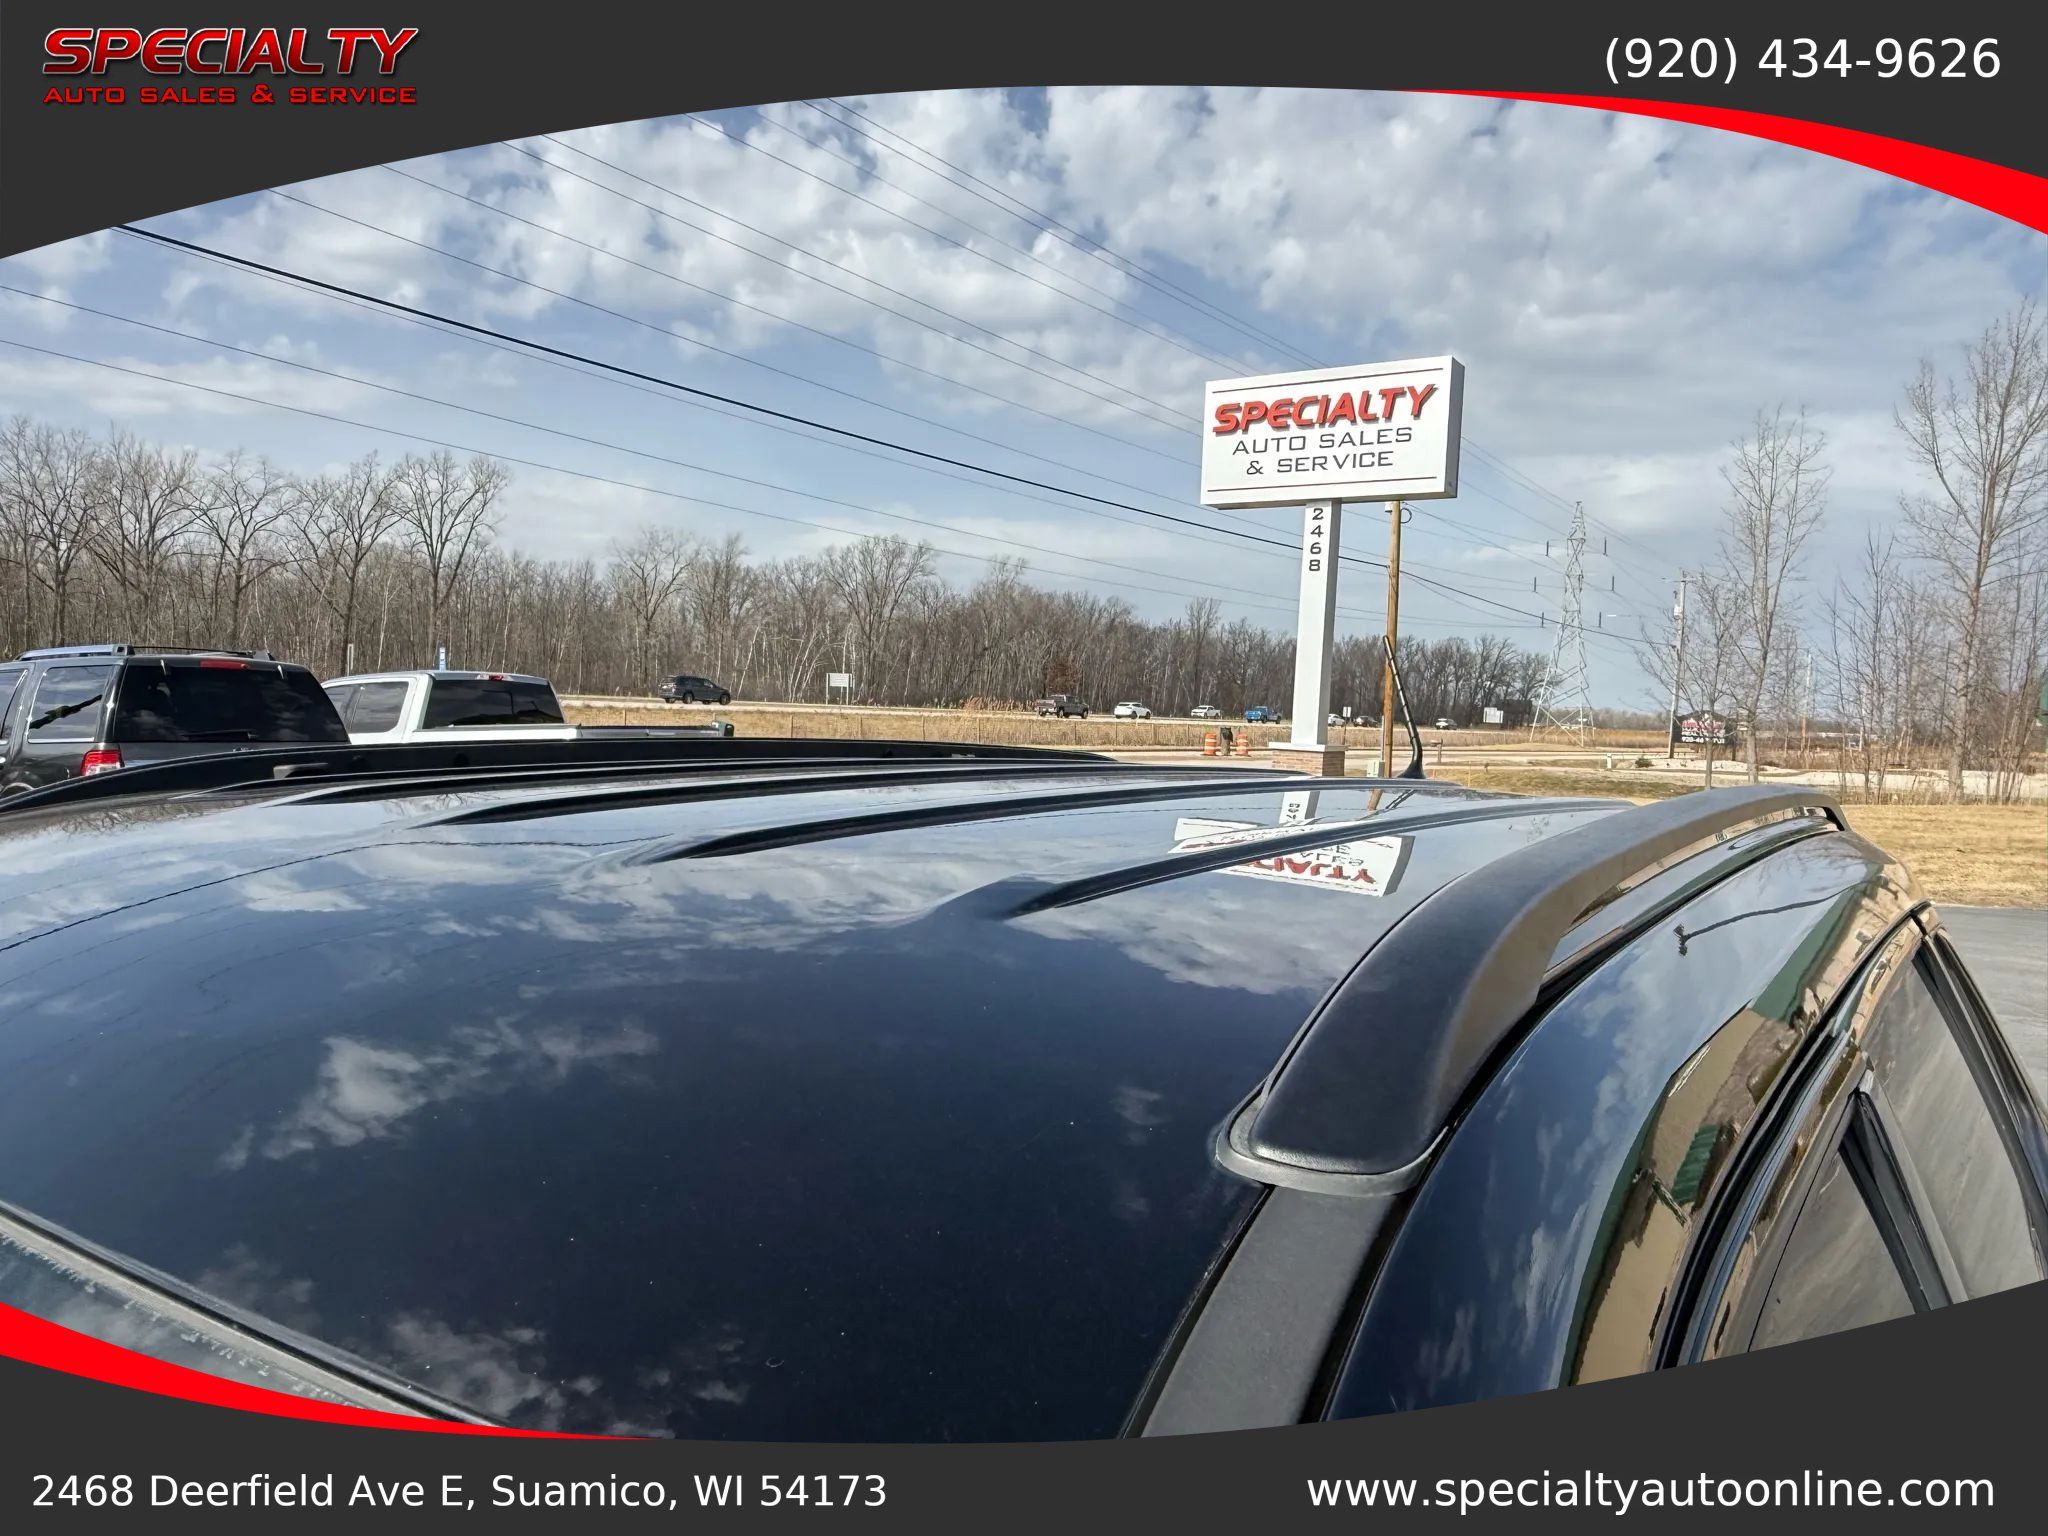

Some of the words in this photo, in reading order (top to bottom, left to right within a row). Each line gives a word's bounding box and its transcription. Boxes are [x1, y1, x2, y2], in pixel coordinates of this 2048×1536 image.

[1212, 384, 1437, 435] SPECIALTY
[1233, 435, 1306, 455] AUTO
[1319, 427, 1413, 449] SALES
[1246, 460, 1264, 475] &
[1277, 451, 1394, 473] SERVICE
[1308, 508, 1324, 572] 2468
